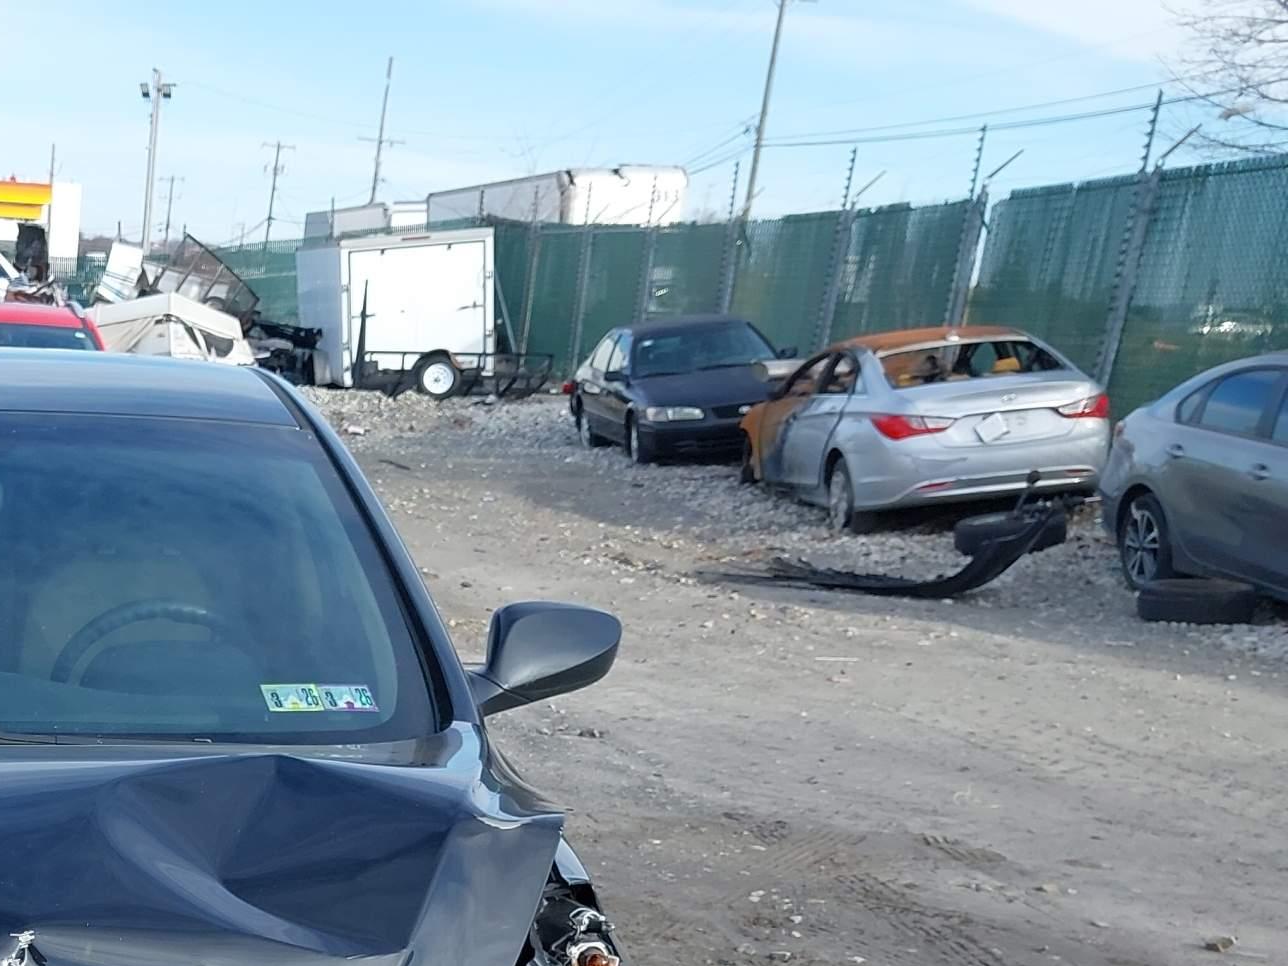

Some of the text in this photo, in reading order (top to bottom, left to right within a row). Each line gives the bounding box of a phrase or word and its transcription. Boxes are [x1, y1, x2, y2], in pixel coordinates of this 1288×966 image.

[270, 687, 320, 708] 3 26
[324, 687, 373, 708] 3 26
